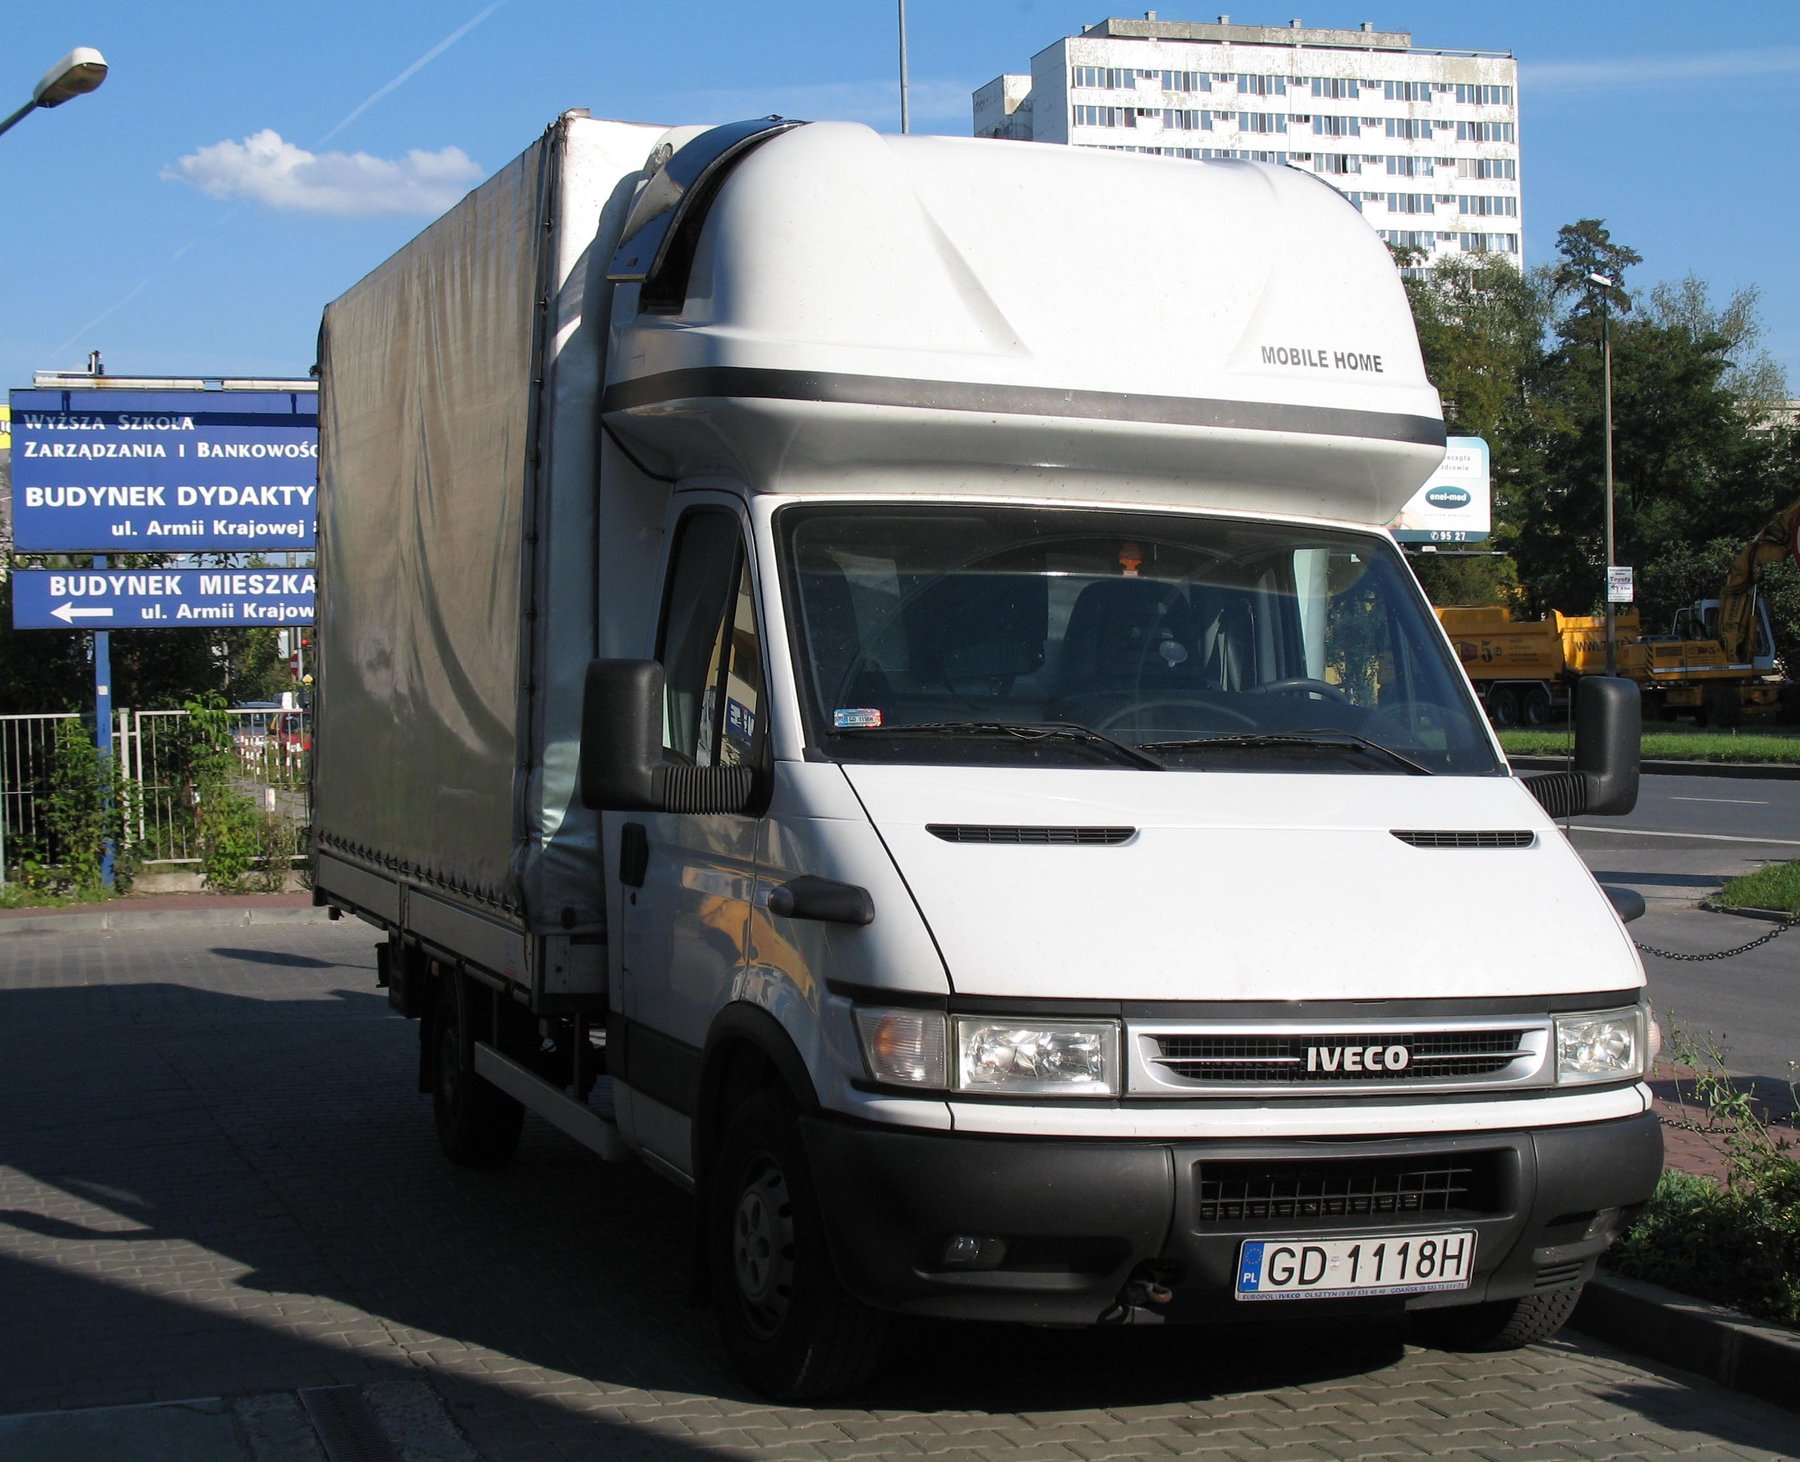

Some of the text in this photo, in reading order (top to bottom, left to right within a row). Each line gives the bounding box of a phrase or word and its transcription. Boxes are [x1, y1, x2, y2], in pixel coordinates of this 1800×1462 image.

[1261, 345, 1384, 373] MOBILE HOME
[25, 486, 315, 507] BUDYNEK DYDAKTY
[1429, 492, 1467, 502] enel-med
[111, 521, 138, 536] ul.
[146, 520, 204, 536] Armii
[213, 520, 305, 539] Krajowej
[50, 575, 316, 596] BUDYNEK MIESZKA
[141, 602, 315, 621] ul. Armii Krajow
[1307, 1045, 1409, 1072] IVECO
[1267, 1238, 1465, 1286] GD 1118H
[1243, 1272, 1257, 1284] PL
